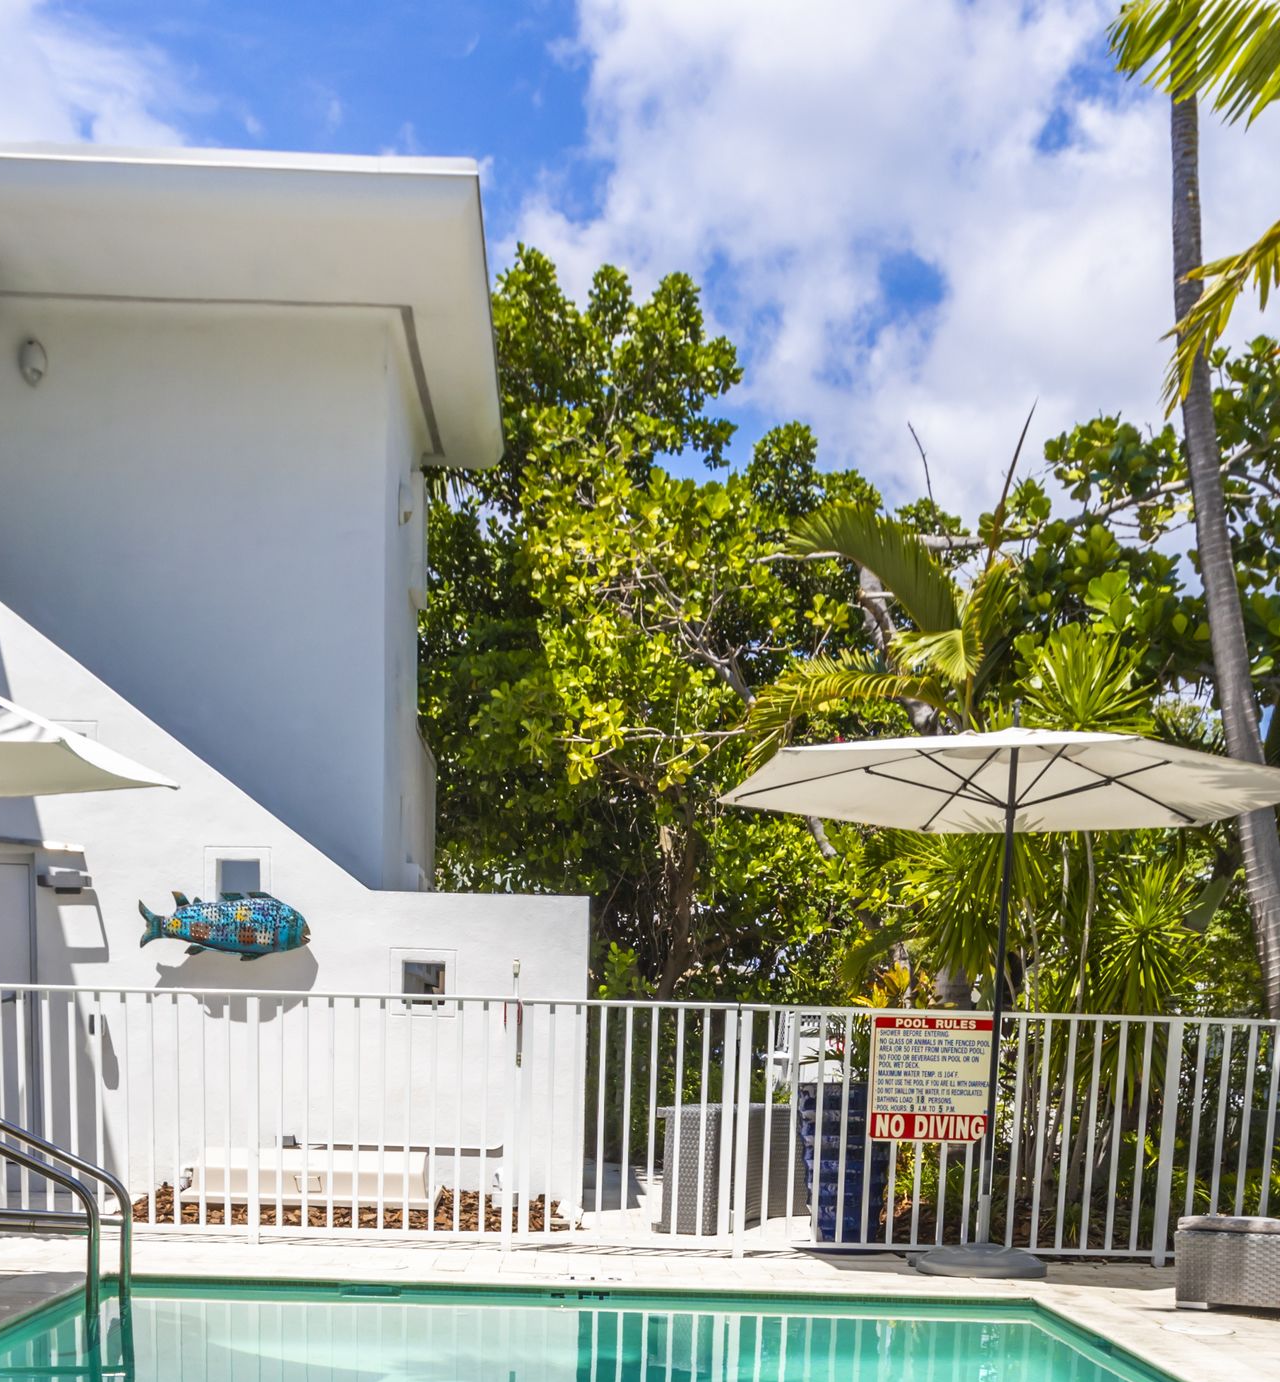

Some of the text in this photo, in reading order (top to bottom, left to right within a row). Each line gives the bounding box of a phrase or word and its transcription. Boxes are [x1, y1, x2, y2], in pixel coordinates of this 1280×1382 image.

[895, 1018, 977, 1030] POOL RULES
[911, 1054, 940, 1062] BEVERAGES
[916, 1095, 925, 1103] 18
[909, 1104, 915, 1112] 9
[938, 1105, 943, 1113] 5
[875, 1114, 985, 1140] NO DIVING
